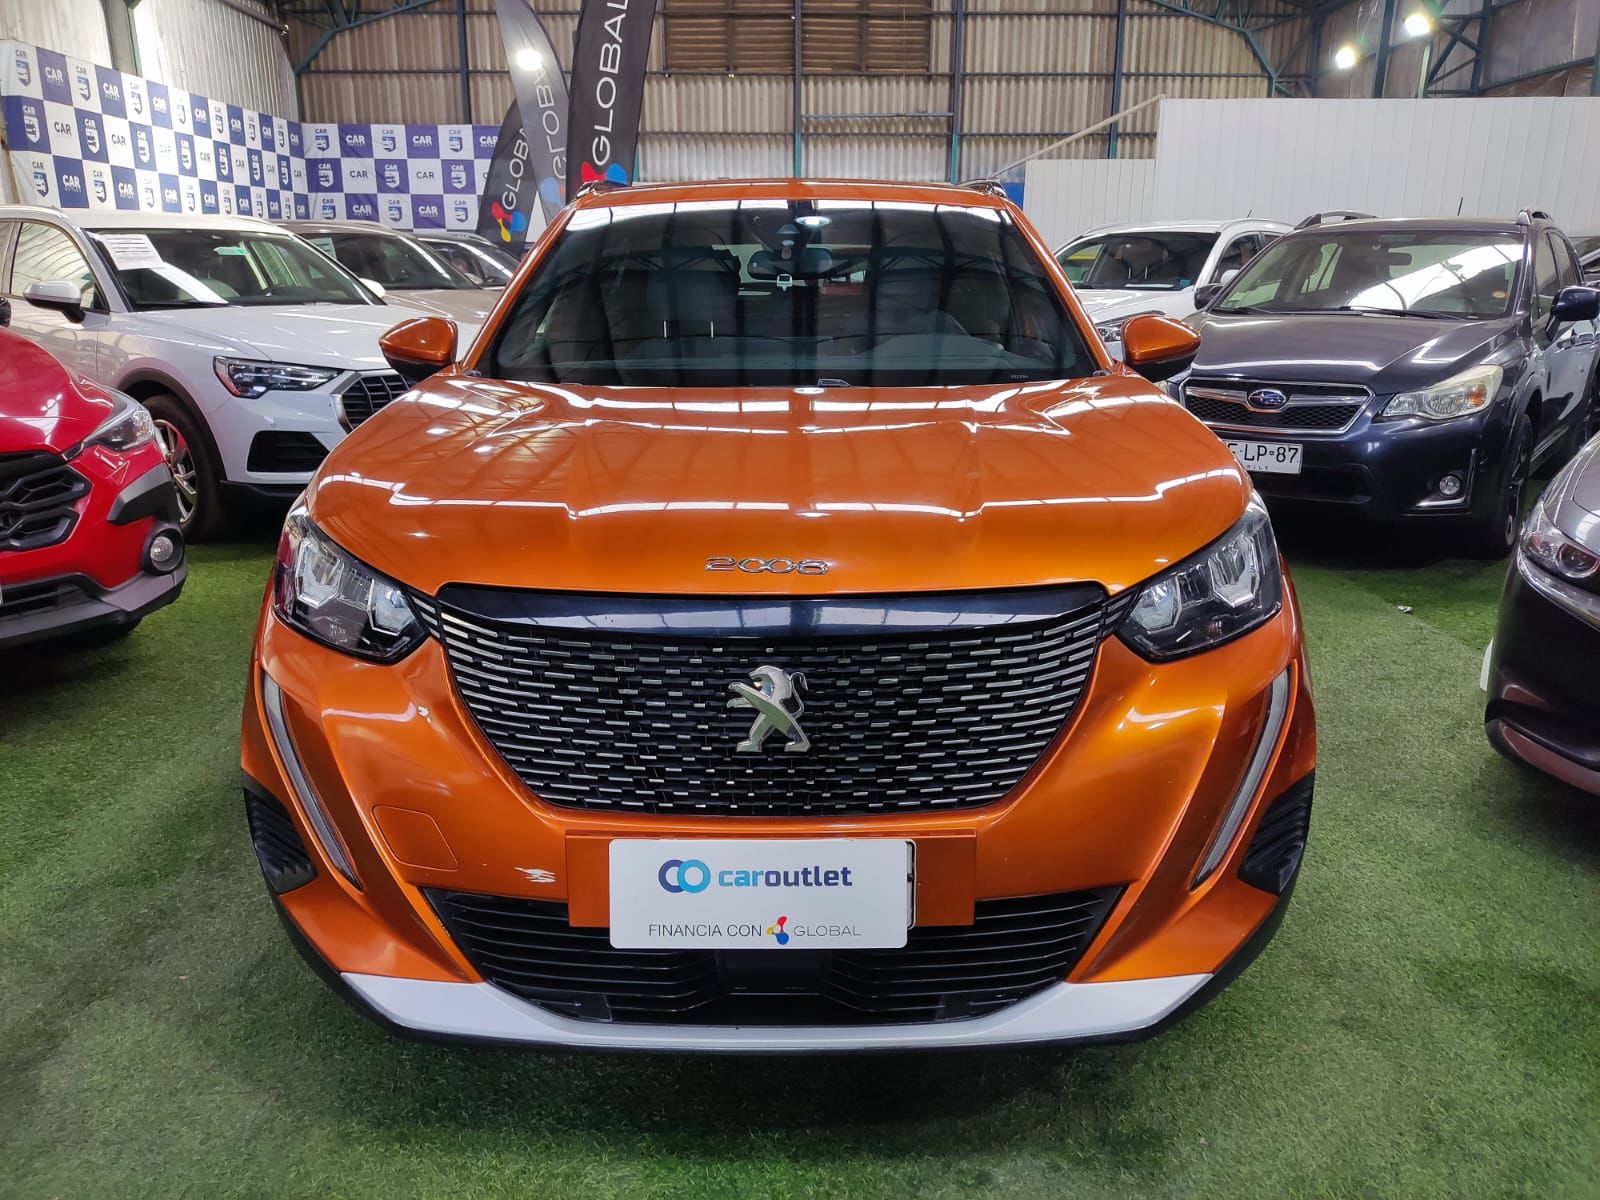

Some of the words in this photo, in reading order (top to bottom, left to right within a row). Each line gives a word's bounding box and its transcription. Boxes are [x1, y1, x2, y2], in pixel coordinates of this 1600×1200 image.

[45, 66, 64, 82] CAR
[592, 0, 628, 166] GLOBAL
[102, 82, 120, 99] CAR
[54, 121, 72, 136] CAR
[111, 133, 127, 146] CAR
[345, 134, 366, 145] CAR
[412, 135, 433, 144] CAR
[32, 160, 45, 170] CAR
[349, 170, 369, 178] CAR
[416, 171, 435, 179] CAR
[62, 174, 81, 188] CAR
[118, 182, 134, 195] CAR
[352, 204, 373, 214] CAR
[418, 205, 439, 215] CAR
[704, 556, 830, 575] 2008
[718, 866, 853, 887] caroutlet
[648, 923, 722, 937] FINANCIA
[726, 923, 762, 937] CON
[793, 924, 862, 937] GLOBAL
